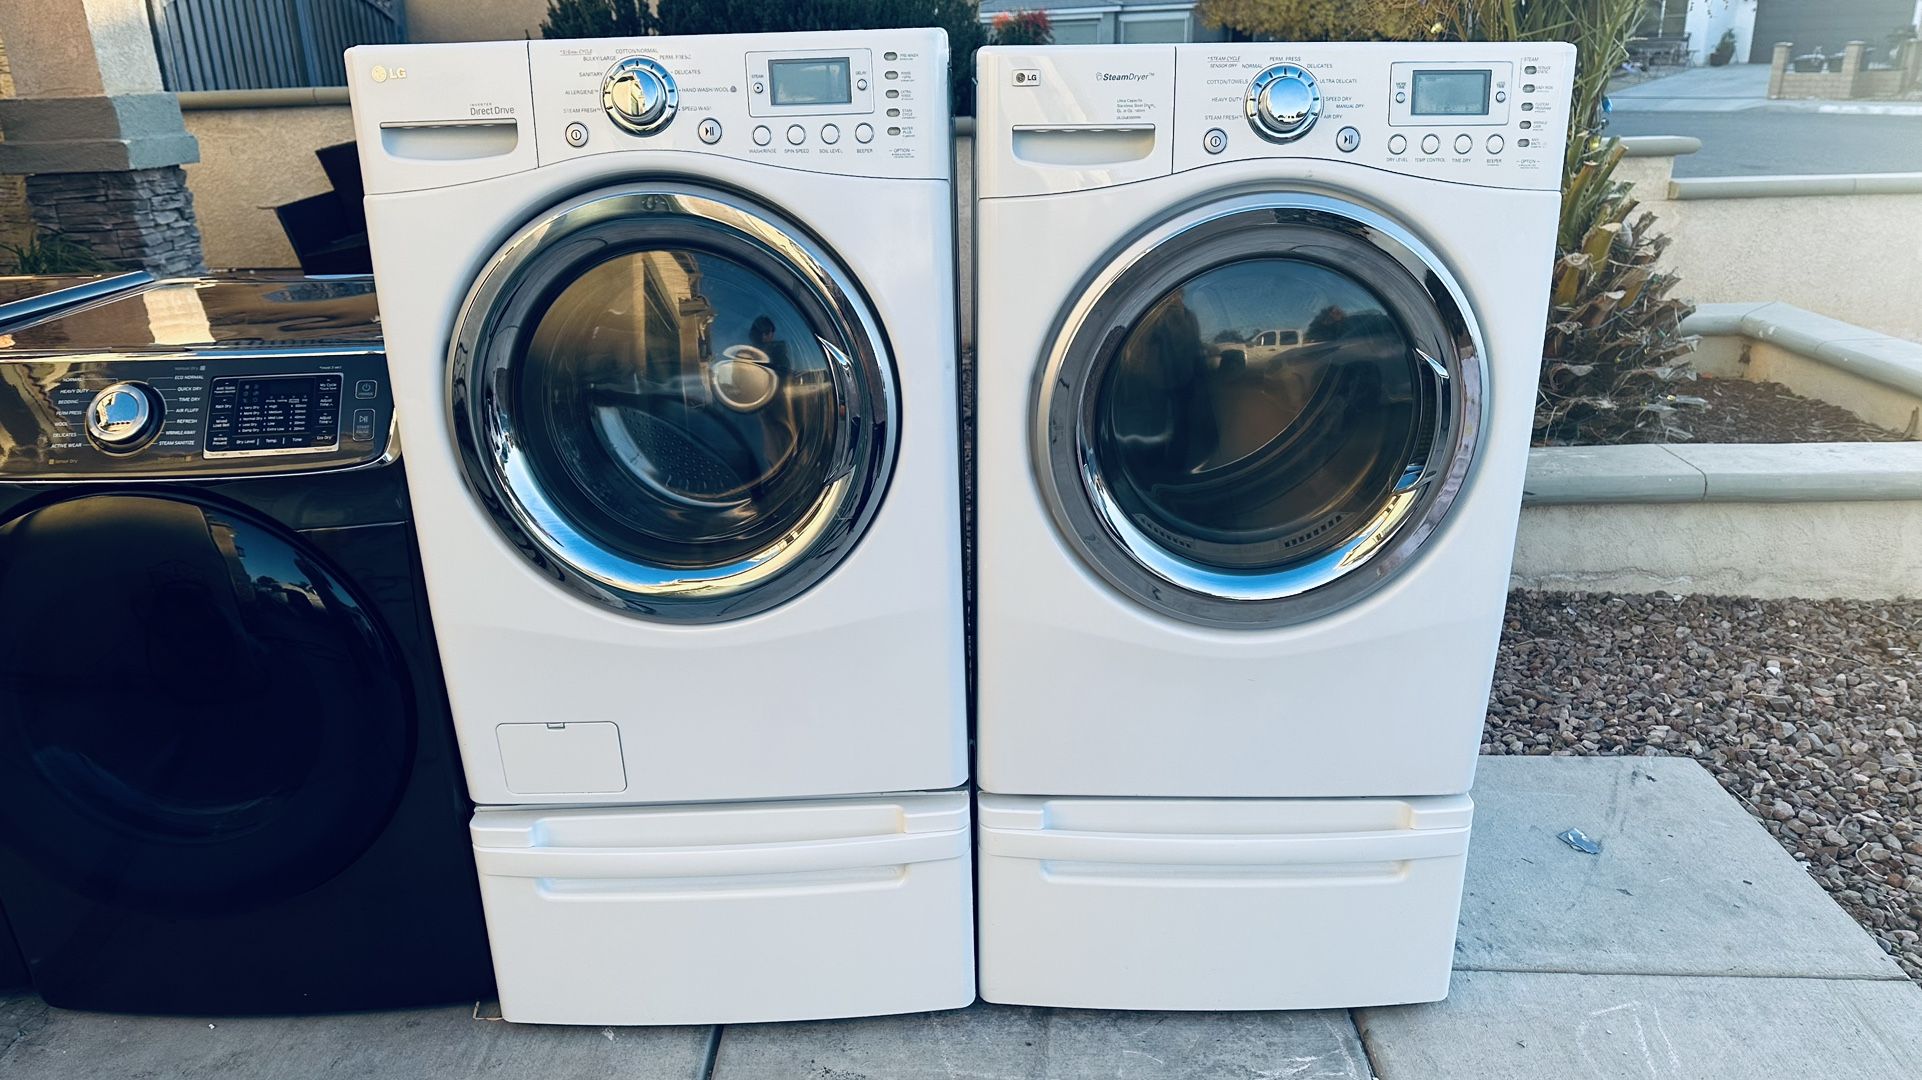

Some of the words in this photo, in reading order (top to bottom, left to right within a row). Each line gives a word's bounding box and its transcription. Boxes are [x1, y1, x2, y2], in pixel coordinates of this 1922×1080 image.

[389, 67, 407, 79] LG
[470, 107, 494, 116] Direct
[494, 106, 515, 115] Drive
[818, 147, 830, 155] SOIL
